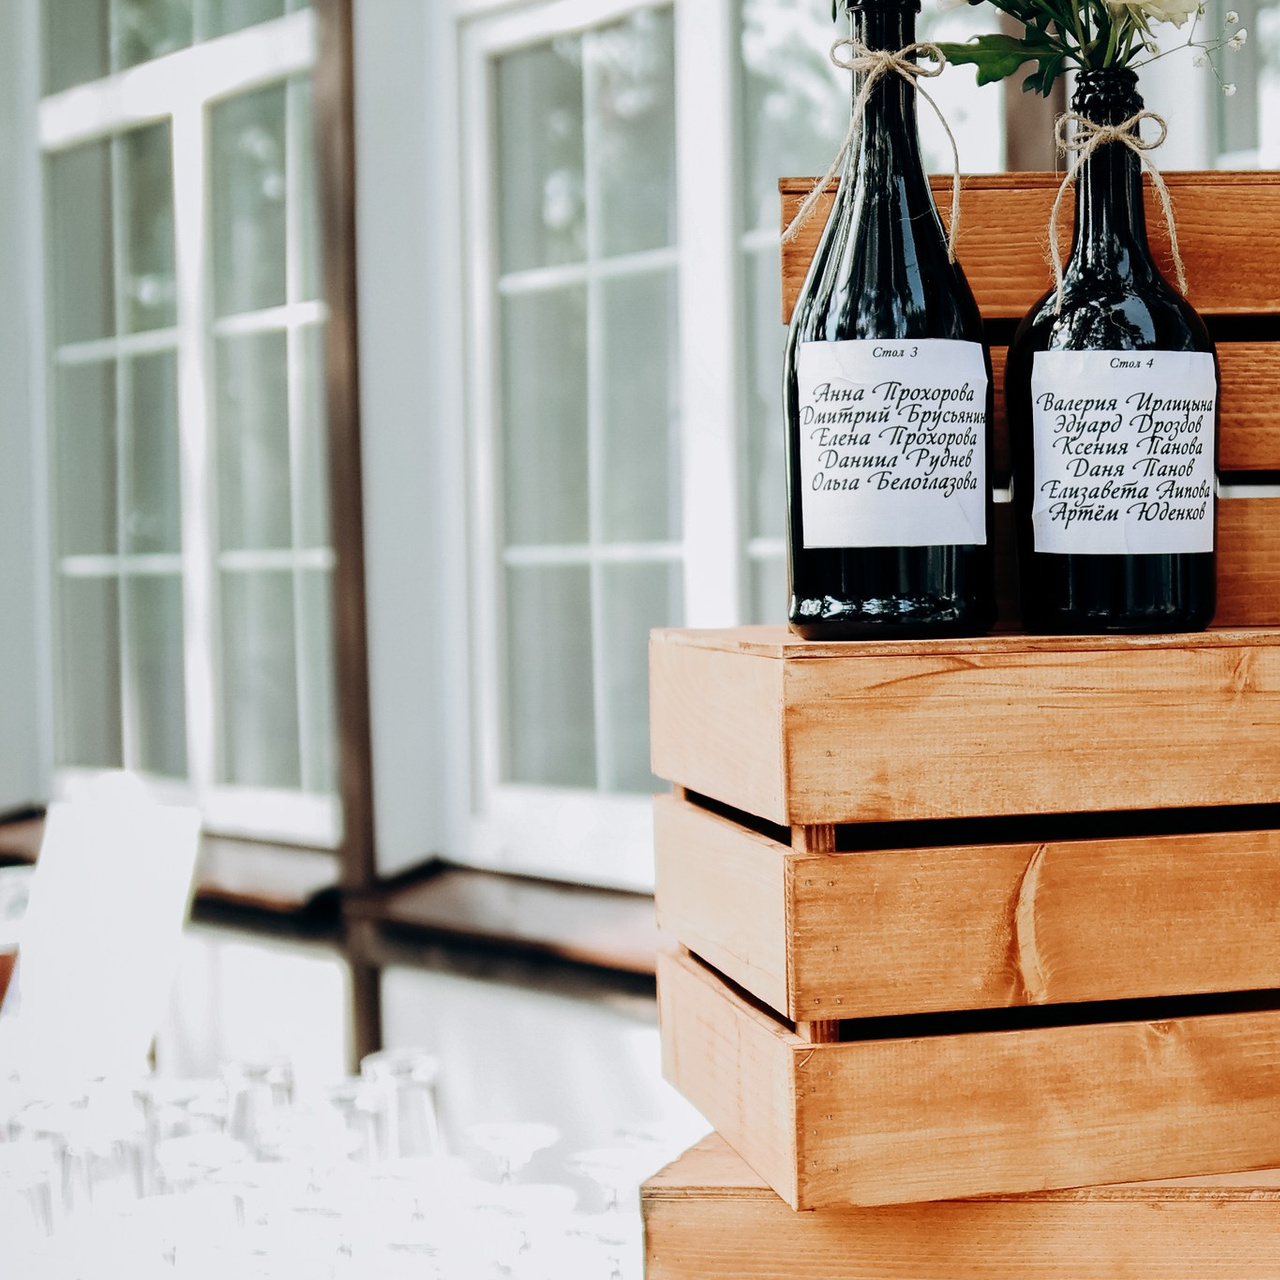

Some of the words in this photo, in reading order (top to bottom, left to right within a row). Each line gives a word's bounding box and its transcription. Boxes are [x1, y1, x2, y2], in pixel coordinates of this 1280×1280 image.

[872, 347, 905, 358] Стол
[910, 347, 918, 357] 3
[1110, 357, 1141, 368] Стол
[1146, 358, 1154, 368] 4
[812, 383, 864, 403] Анна
[872, 381, 974, 410] Прохорова
[1036, 392, 1117, 420] Валерия
[1126, 392, 1213, 418] Ирлицына
[799, 405, 891, 432] Дмитрий
[898, 403, 986, 432] Брусьянин
[1054, 414, 1122, 441] Эдуард
[1129, 414, 1203, 441] Дроздов
[810, 427, 871, 447] Елена
[878, 426, 977, 454] Прохорова
[1052, 436, 1129, 455] Ксения
[1136, 436, 1203, 455] Панова
[818, 449, 898, 469] Даниил
[906, 448, 973, 476] Руднев
[1066, 457, 1125, 478] Даня
[1133, 457, 1195, 478] Панов
[812, 472, 860, 491] Ольга
[867, 471, 977, 498] Белоглазова
[1041, 480, 1149, 507] Елизавета
[1049, 502, 1119, 530] Артём
[1126, 501, 1206, 521] Юденков
